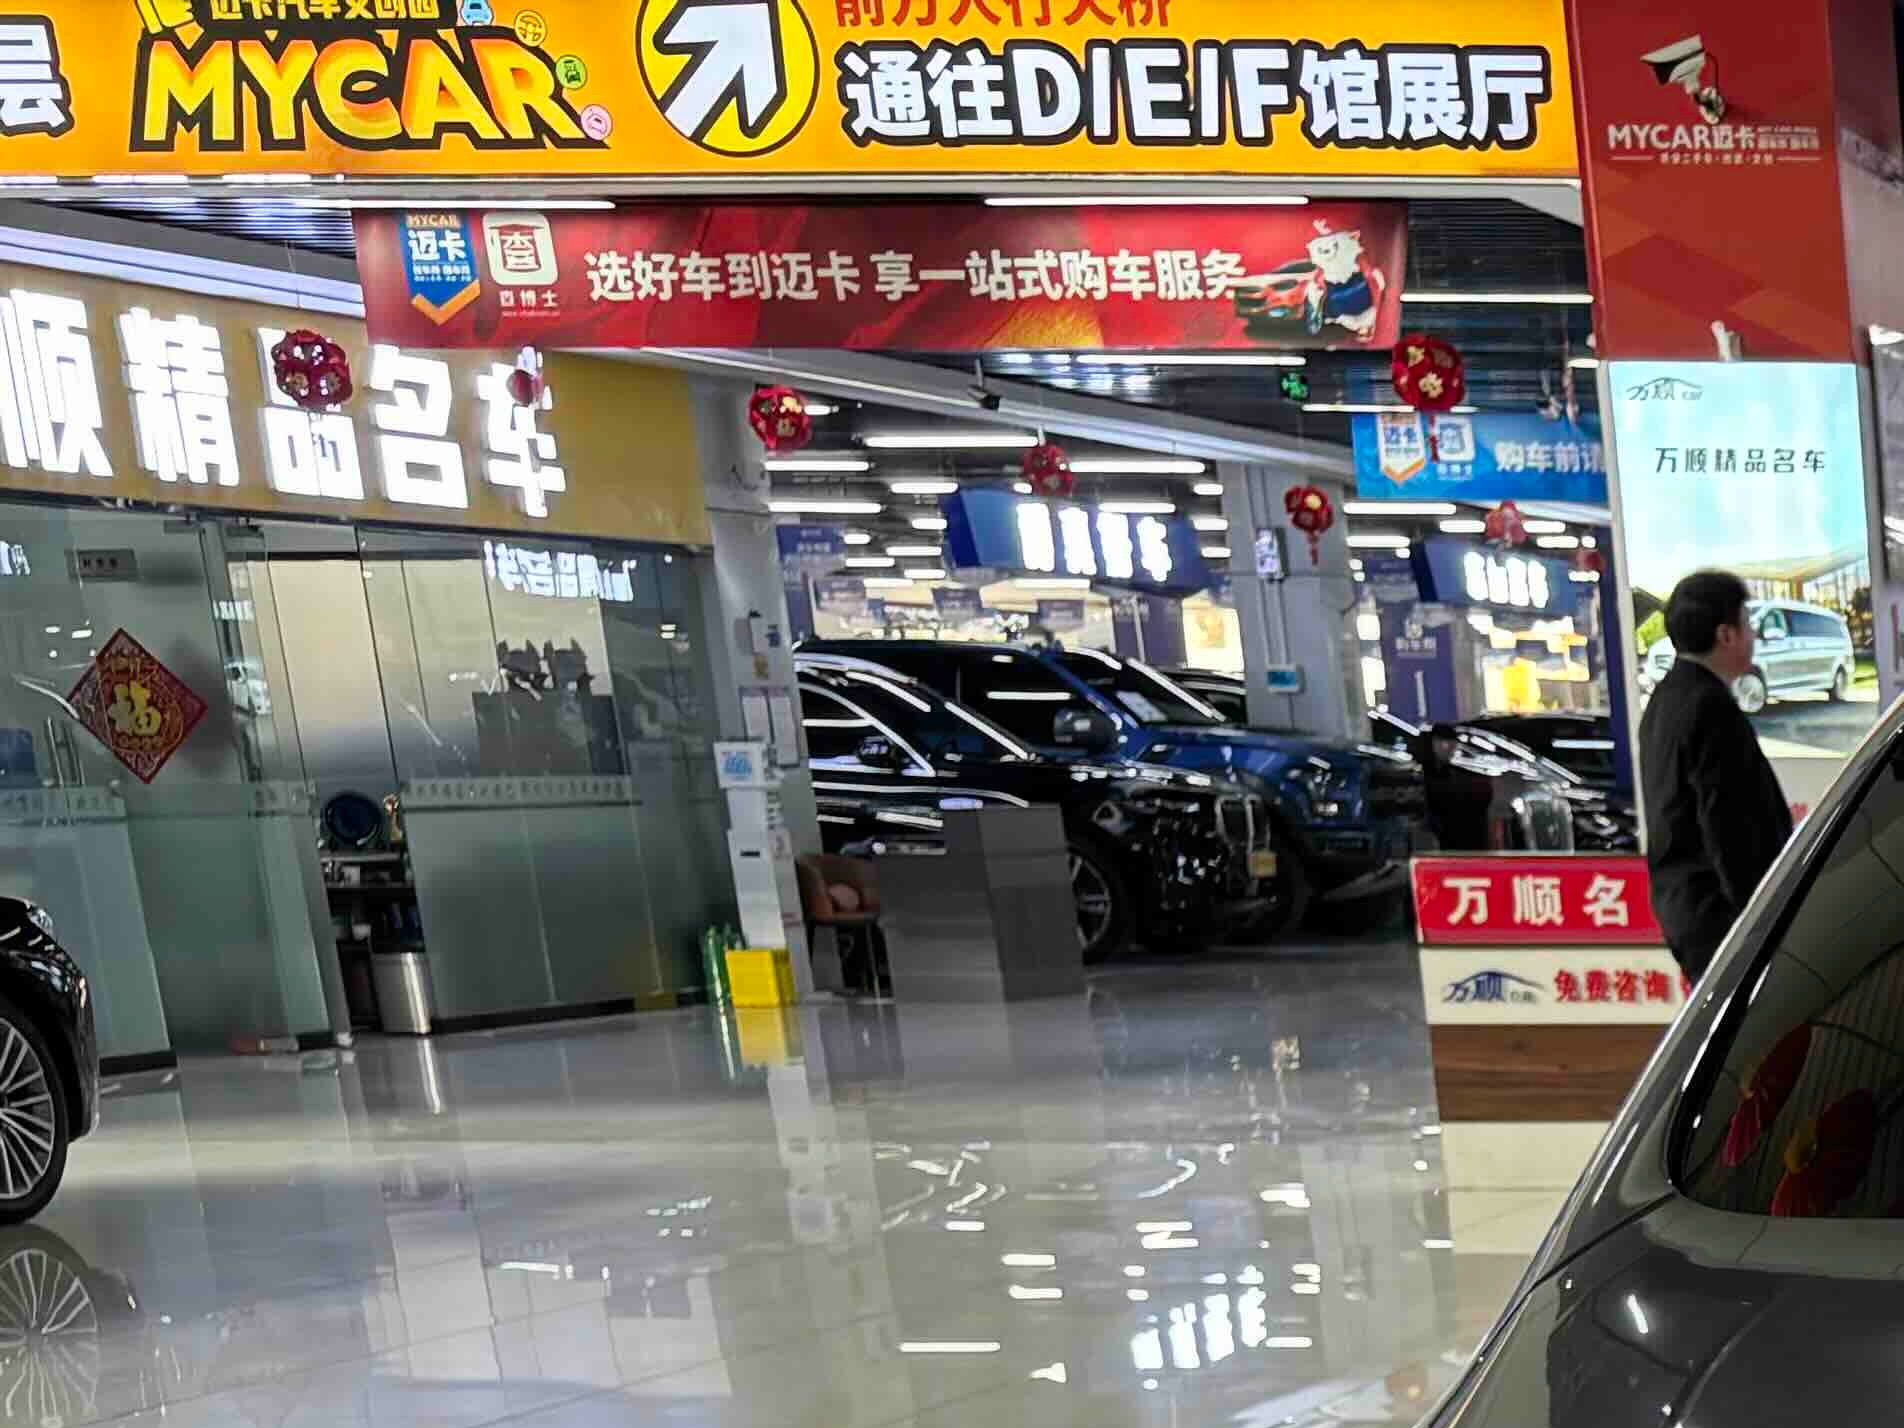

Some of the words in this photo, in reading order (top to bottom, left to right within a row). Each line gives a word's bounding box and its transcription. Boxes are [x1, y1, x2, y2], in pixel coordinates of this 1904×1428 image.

[137, 36, 605, 146] MYCAR
[845, 46, 1546, 143] 通往DIEIF馆展厅
[408, 229, 467, 262] 迈卡
[584, 250, 862, 303] 选好车到迈卡
[873, 249, 1248, 303] 享一站式购车服务
[1655, 447, 1828, 474] 万顺精品名车
[1443, 874, 1630, 927] 万顺名
